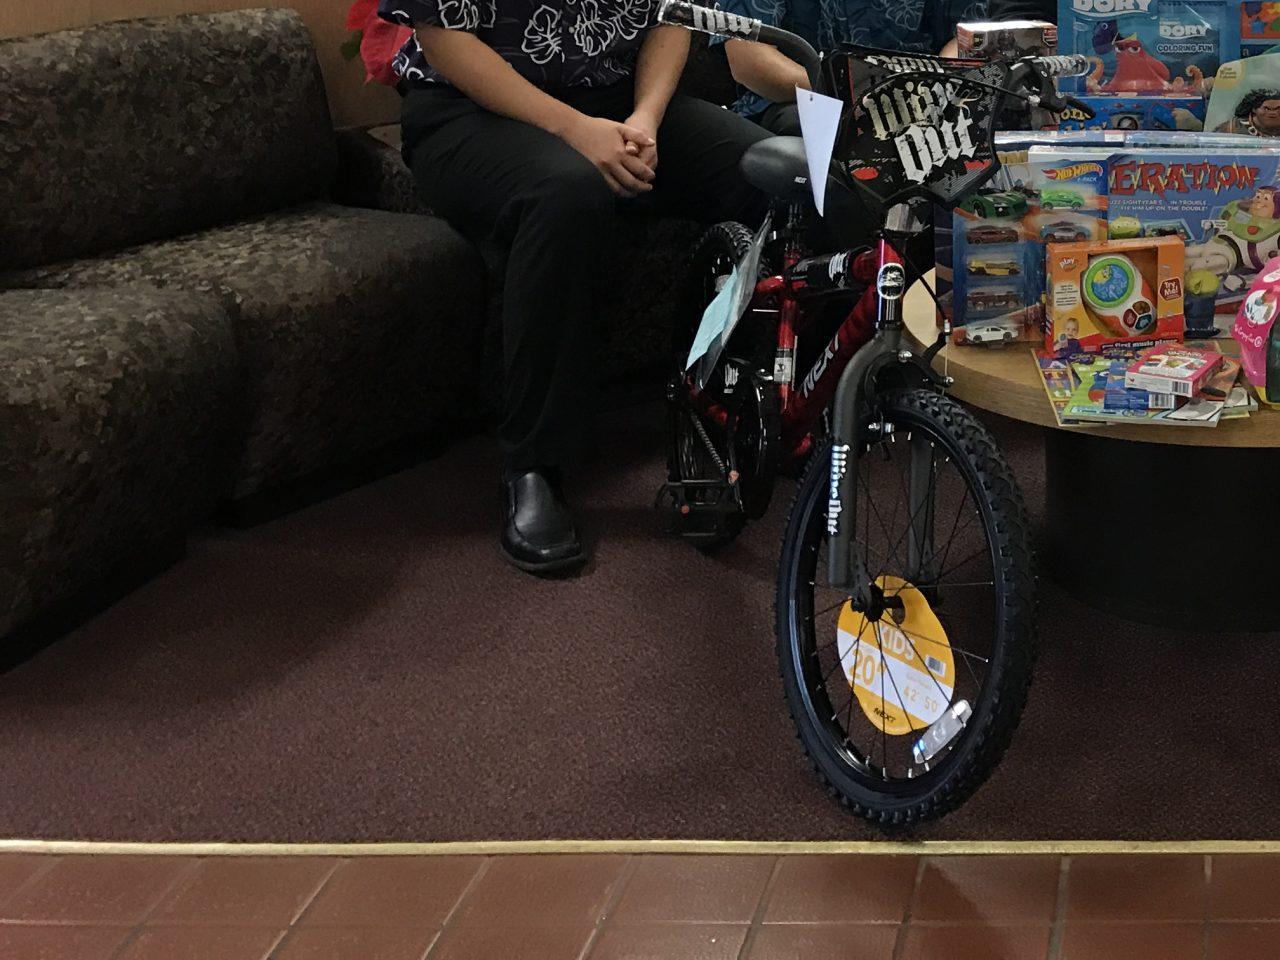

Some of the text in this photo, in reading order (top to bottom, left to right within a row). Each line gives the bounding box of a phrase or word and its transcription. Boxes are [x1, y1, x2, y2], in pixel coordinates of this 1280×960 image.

[1159, 25, 1208, 38] DORY
[1157, 43, 1214, 53] COLORING FUN
[1059, 257, 1075, 269] play
[1163, 281, 1176, 290] Try
[1163, 286, 1178, 296] Me!
[1132, 340, 1154, 348] music
[878, 623, 916, 661] KIDS
[873, 707, 896, 724] NEXT
